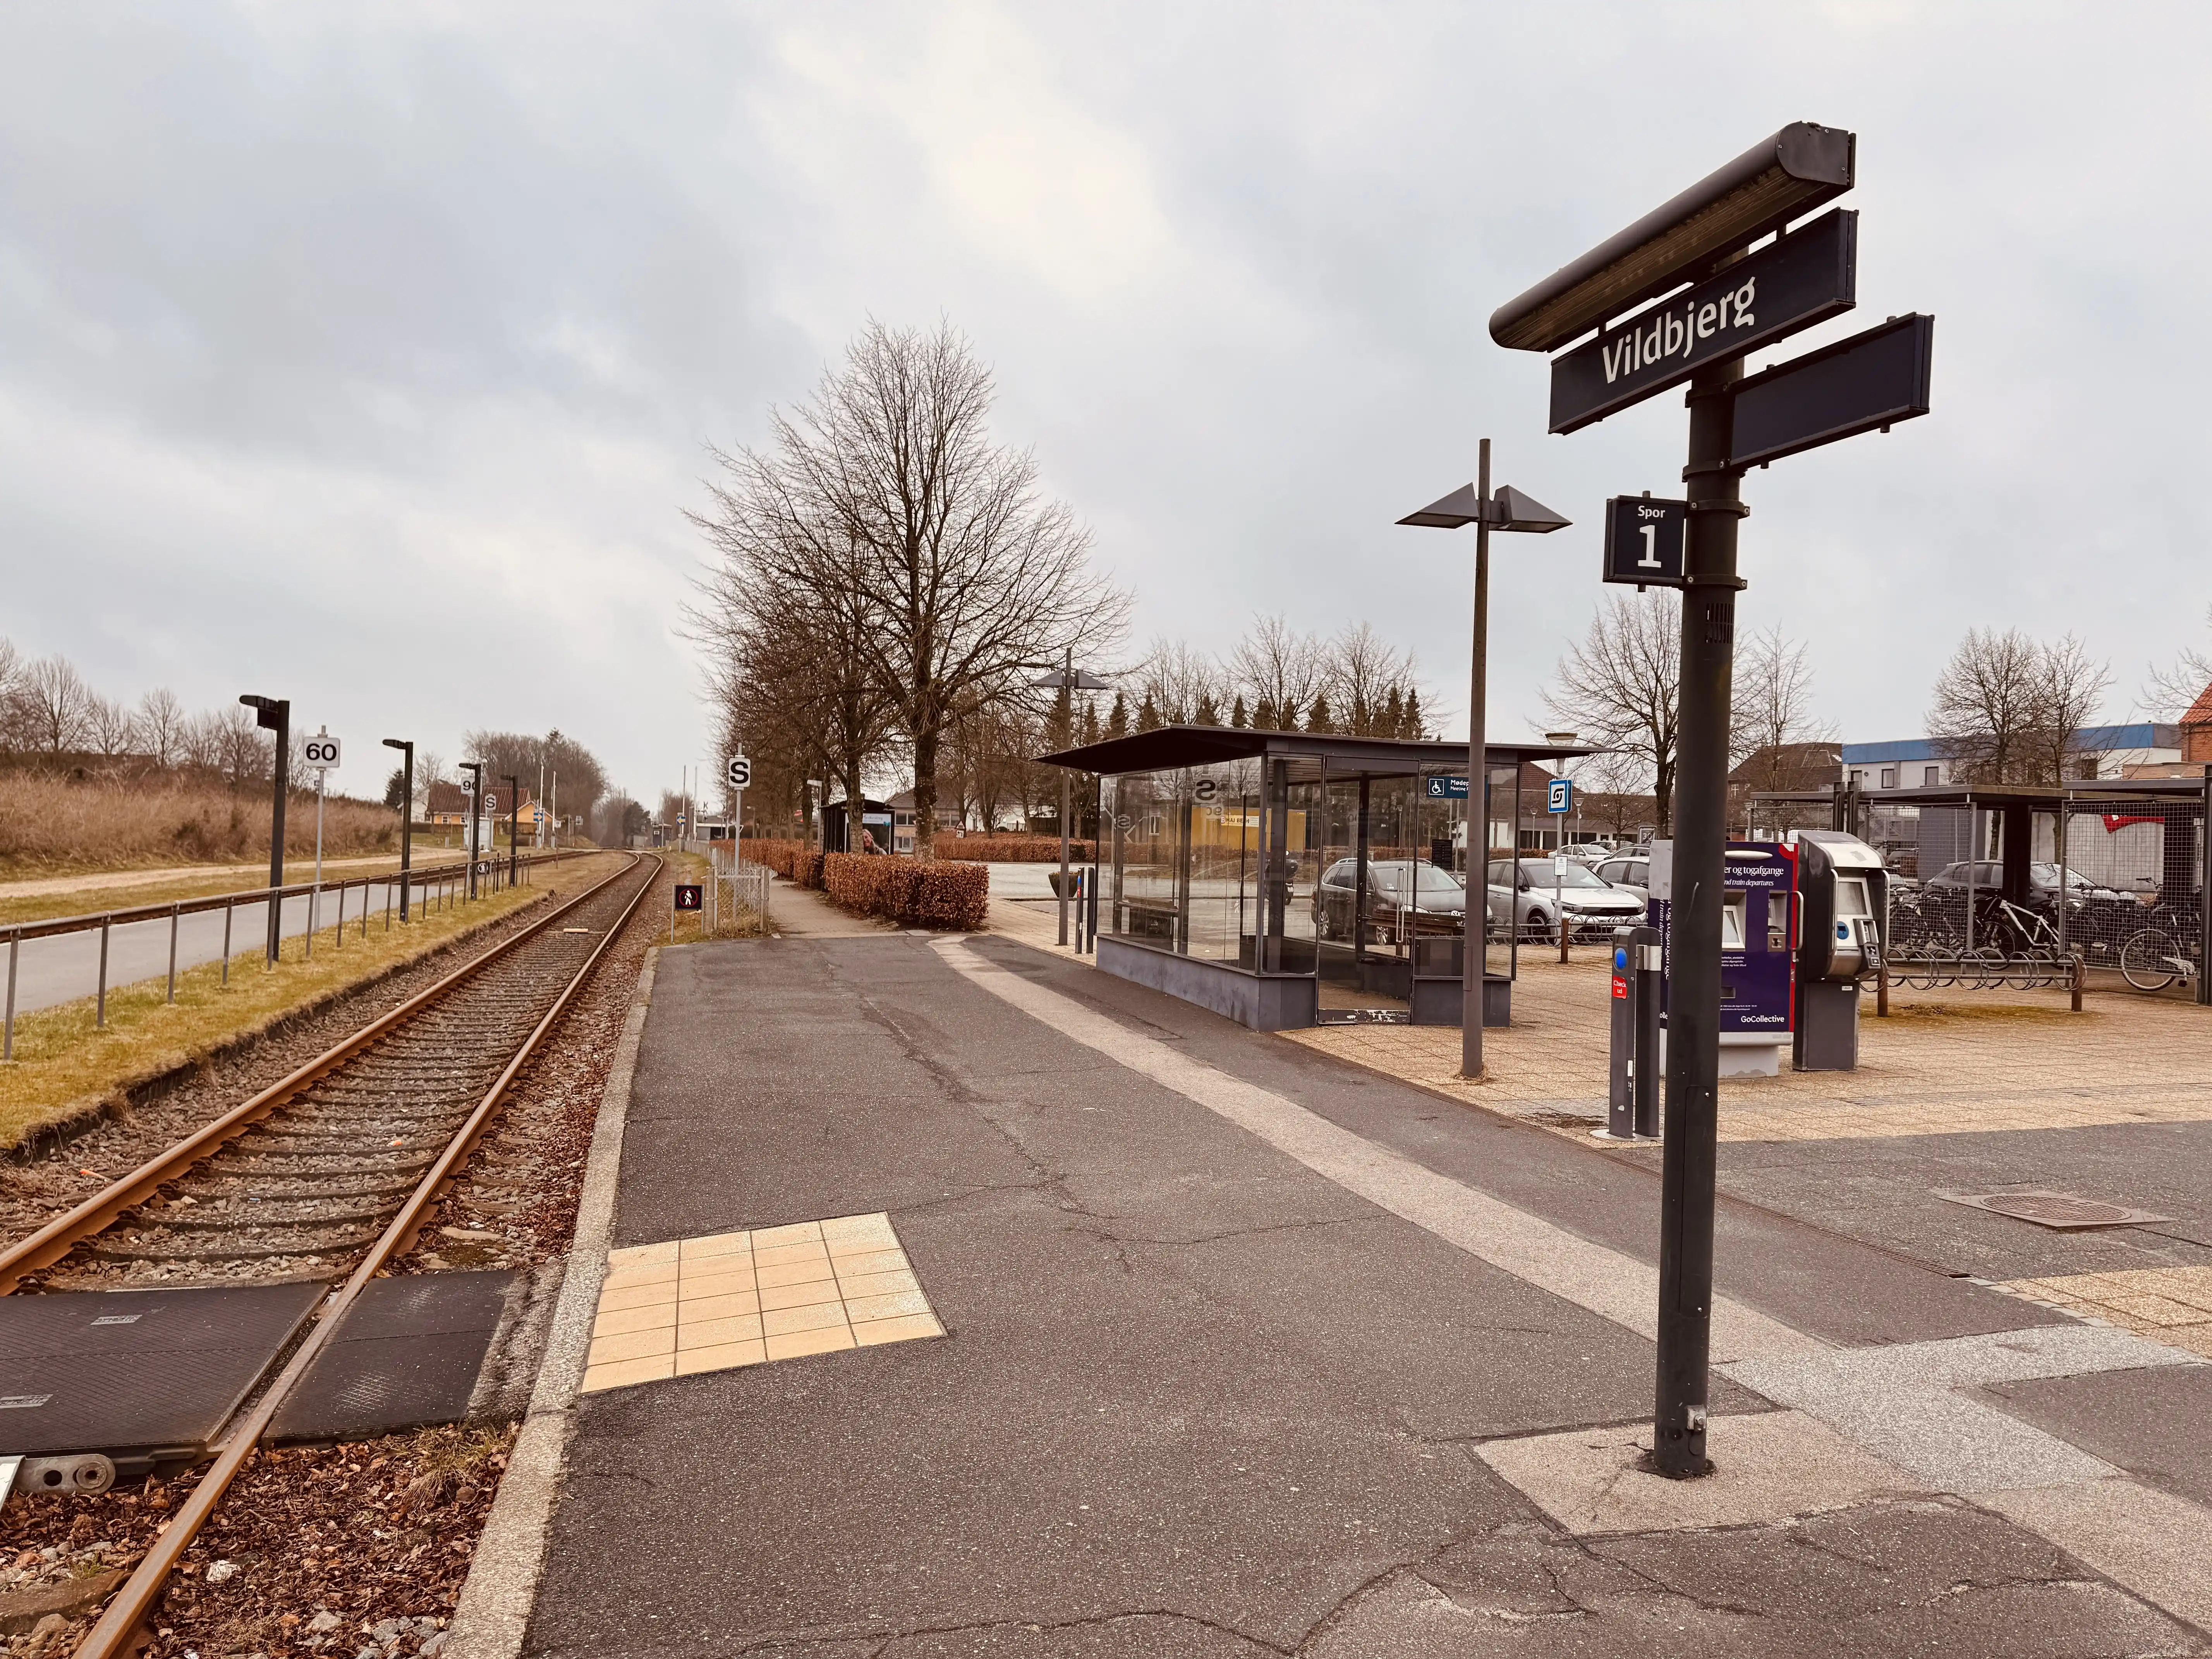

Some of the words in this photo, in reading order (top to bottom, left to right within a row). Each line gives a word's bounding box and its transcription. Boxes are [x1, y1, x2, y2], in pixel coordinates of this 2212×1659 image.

[1602, 276, 1755, 383] Vildbjerg
[1638, 505, 1665, 519] Spor
[1638, 525, 1661, 568] 1
[306, 743, 337, 761] 60
[730, 761, 749, 784] S
[486, 797, 495, 808] S
[1733, 867, 1742, 876] og
[1743, 866, 1784, 876] togafgange
